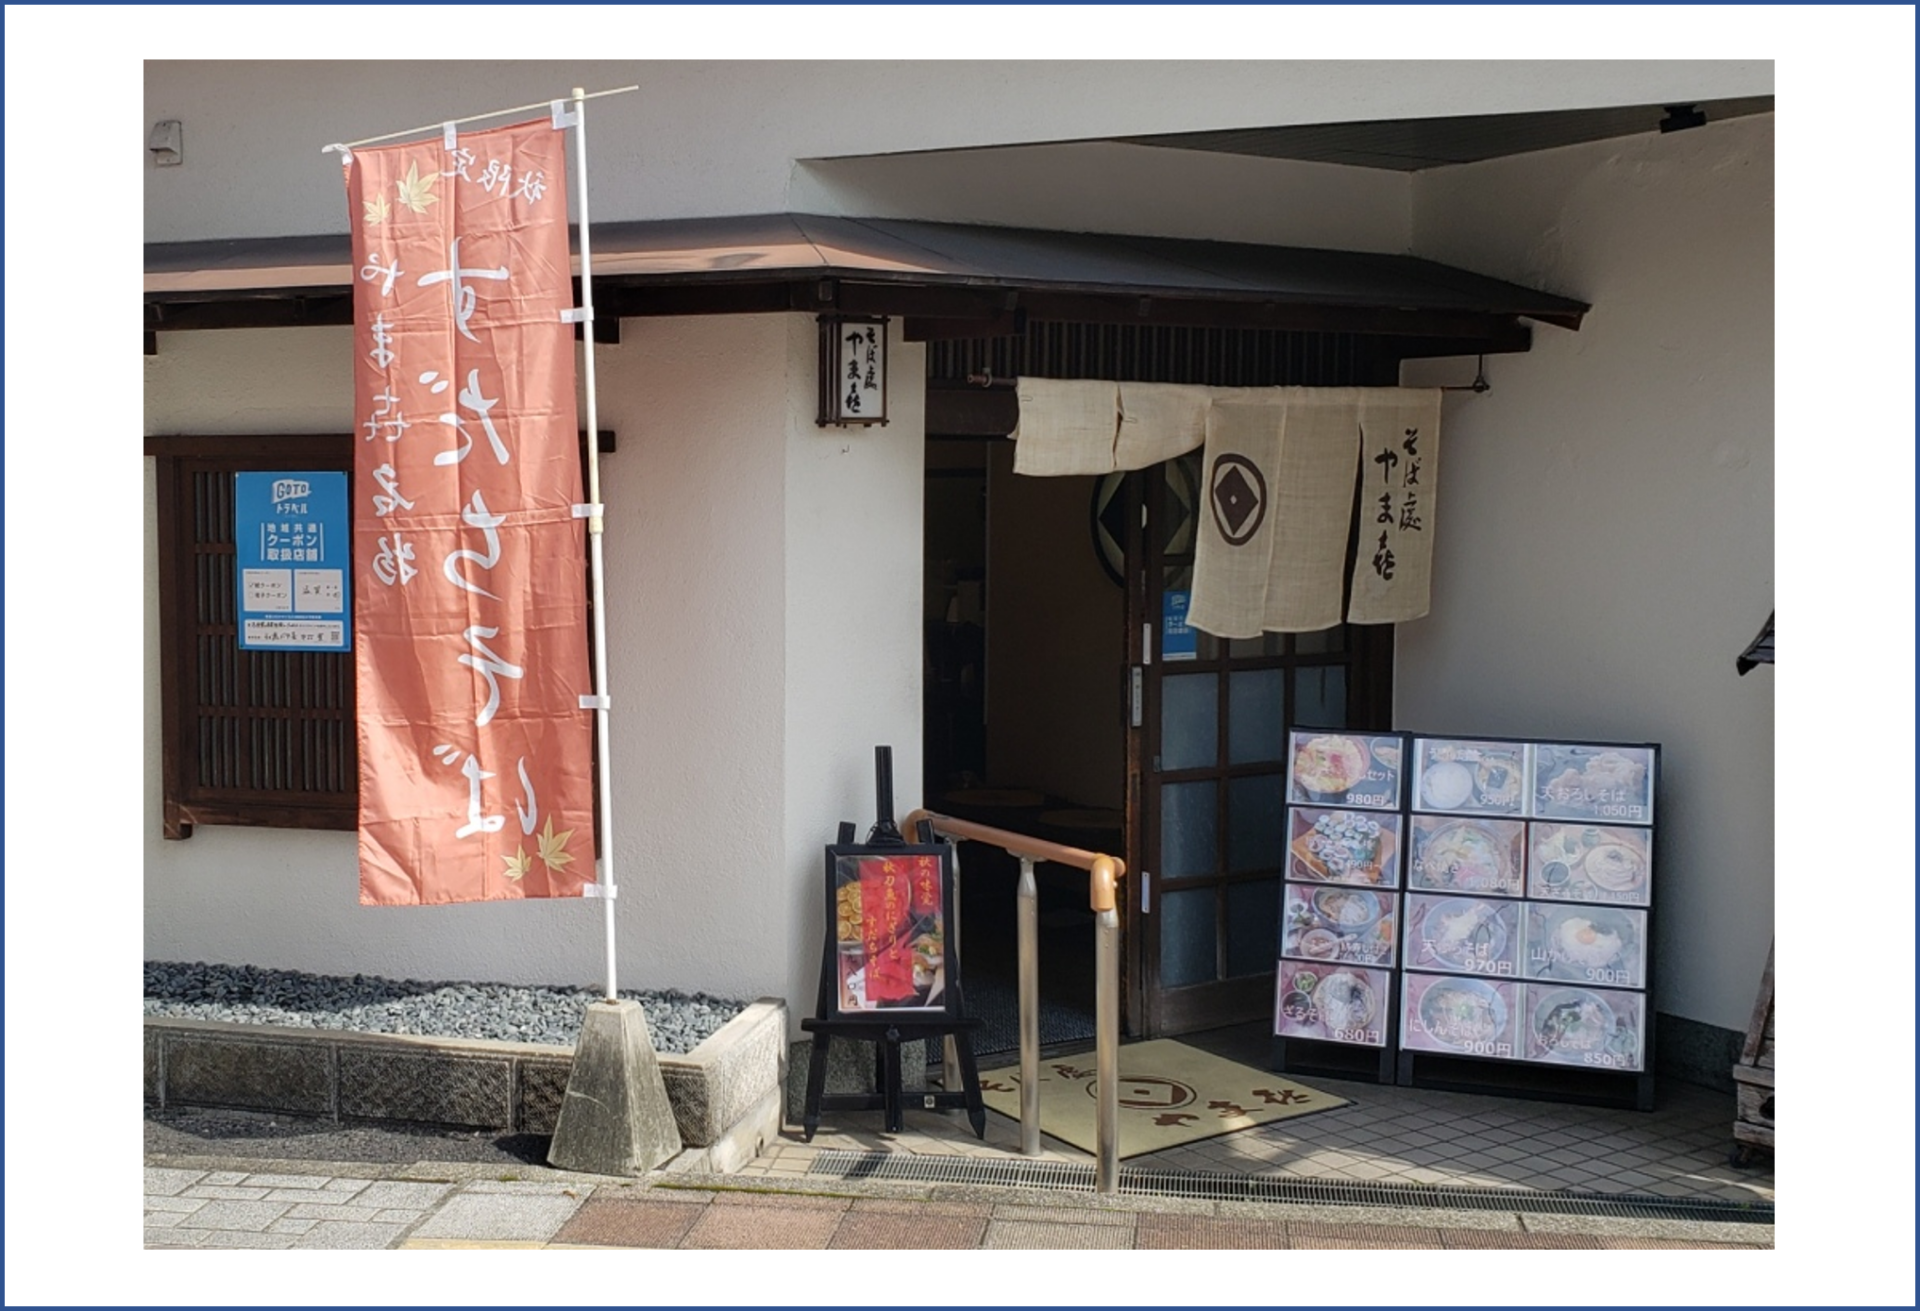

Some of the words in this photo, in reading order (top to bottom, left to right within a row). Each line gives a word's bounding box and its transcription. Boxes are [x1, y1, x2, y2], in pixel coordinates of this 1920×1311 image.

[276, 503, 308, 514] トラベル
[267, 523, 317, 533] 地域共通
[267, 534, 317, 546] クーポン
[1346, 793, 1384, 805] 980円
[1540, 786, 1627, 802] 天おろしそば
[918, 856, 934, 906] 秋の味覚
[882, 860, 900, 960] 秋刀魚のにぎりと
[865, 915, 881, 979] すだちそば
[1464, 959, 1512, 975] 970円
[1586, 967, 1631, 984] 900円
[1334, 1027, 1380, 1043] 680円
[1464, 1040, 1512, 1058] 900円
[1584, 1052, 1626, 1067] 850円
